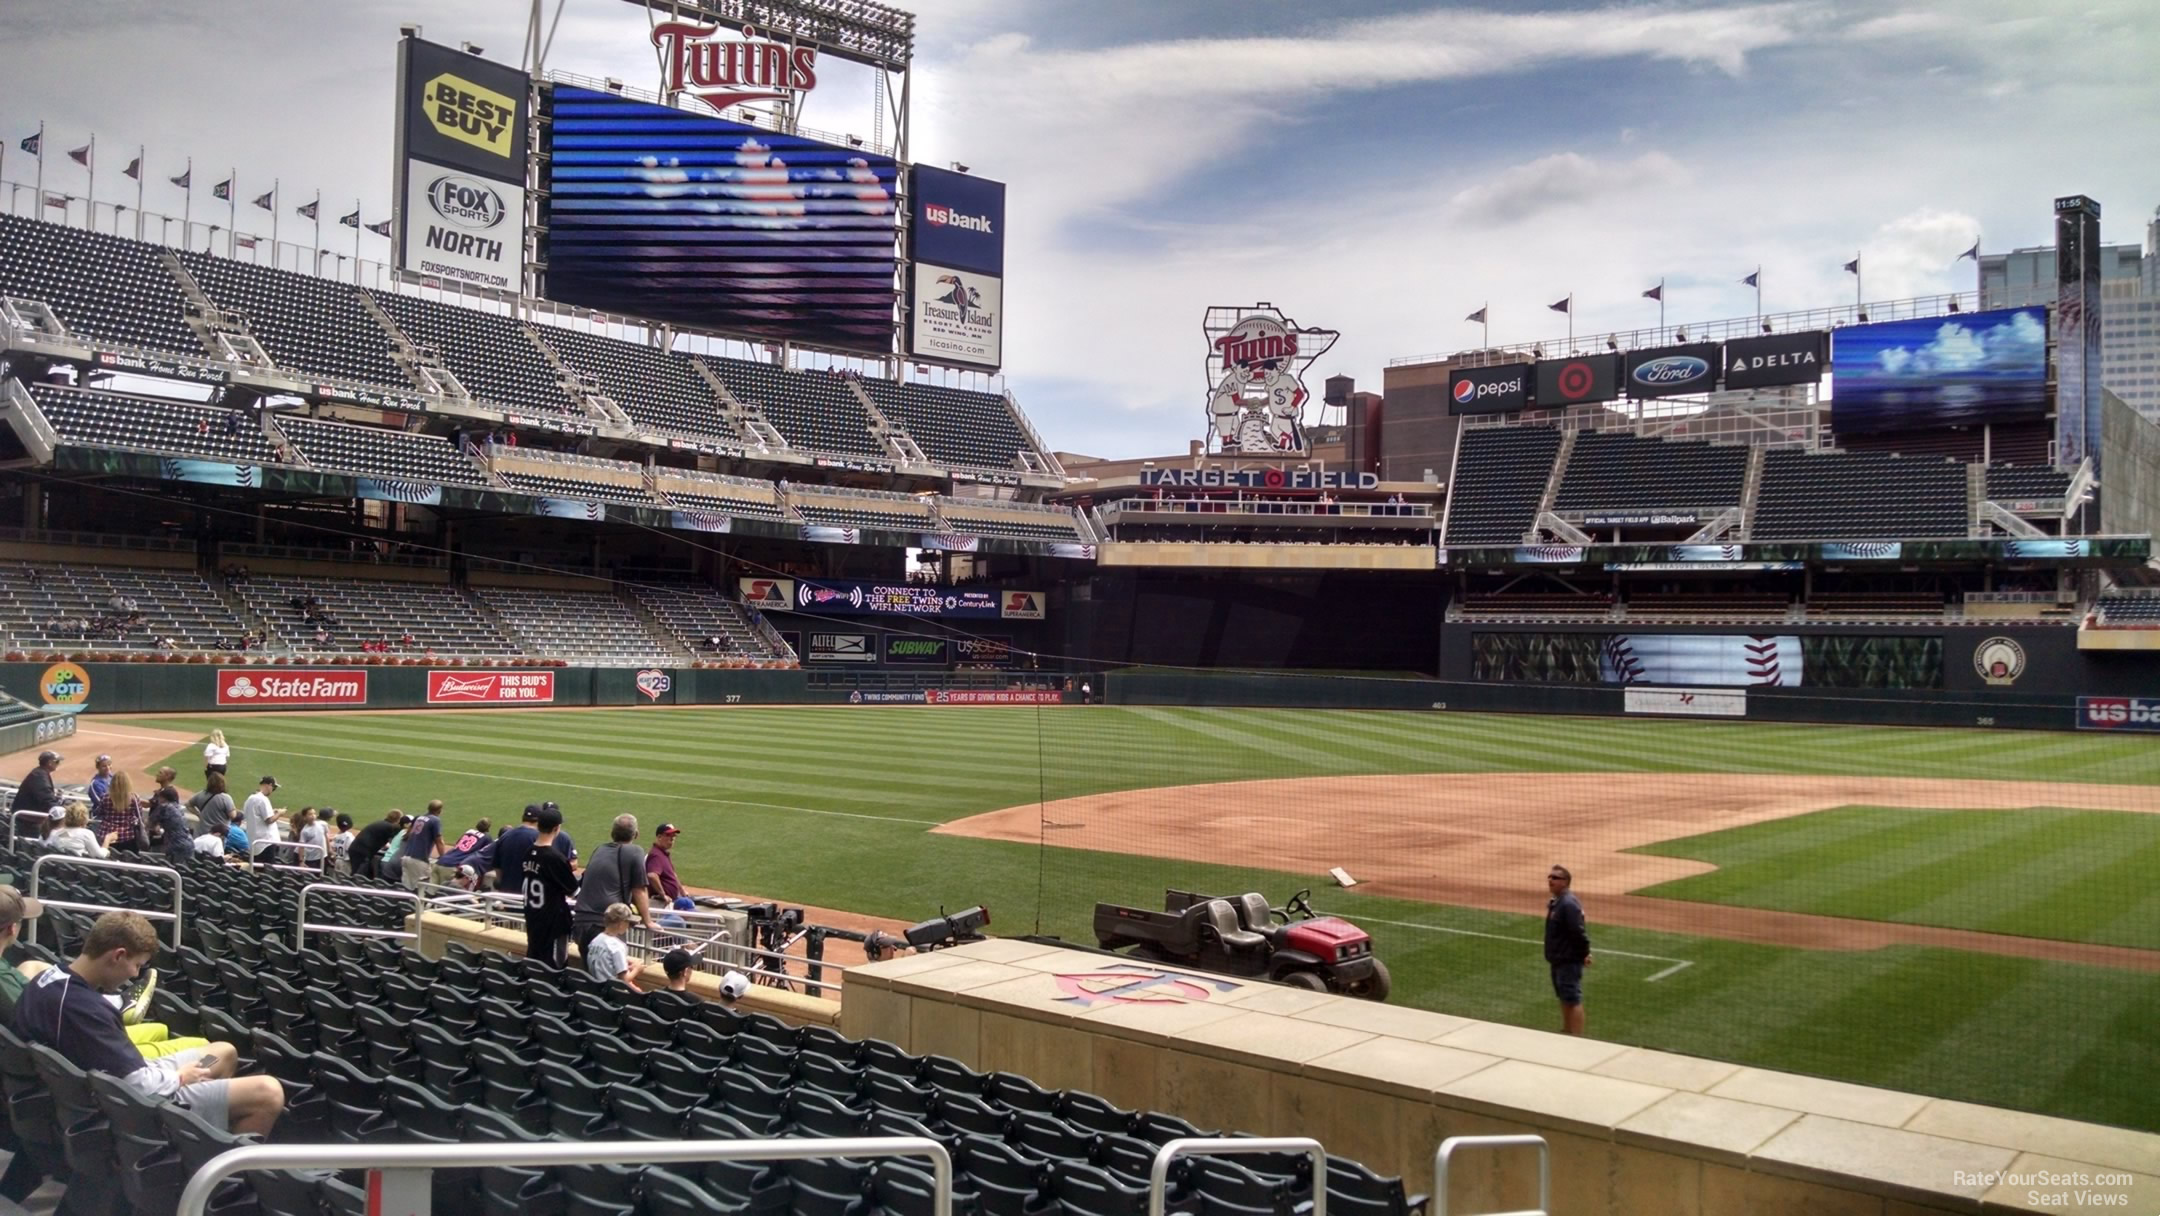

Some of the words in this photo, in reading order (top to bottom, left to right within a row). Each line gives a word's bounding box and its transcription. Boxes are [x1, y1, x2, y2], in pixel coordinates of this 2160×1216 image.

[651, 21, 817, 93] Twins
[435, 82, 513, 127] BEST
[436, 104, 505, 144] BUY
[444, 182, 489, 214] FOX
[443, 204, 490, 223] SPORTS
[426, 225, 503, 262] NORTH
[420, 260, 508, 287] FOXSPORTSNORTH.COM
[923, 301, 959, 322] Treasure
[967, 309, 993, 328] Island
[923, 319, 954, 328] RESORT
[963, 326, 993, 335] CASINO
[929, 338, 985, 355] ticasino.com
[1215, 330, 1298, 370] Twins
[1752, 352, 1816, 369] DELTA
[149, 361, 175, 375] Home
[177, 365, 197, 378] Run
[199, 369, 224, 382] Porch
[1648, 361, 1693, 382] Ford
[1477, 378, 1522, 399] pepsi
[359, 392, 380, 404] Home
[382, 396, 398, 408] Run
[1140, 468, 1260, 486] TARGET
[1292, 471, 1379, 489] FIELD
[1660, 514, 1696, 525] Ballpark
[865, 594, 885, 604] THE
[887, 595, 911, 605] FREE
[912, 596, 944, 606] TWINS
[873, 586, 921, 598] CONNECT
[922, 588, 936, 598] TO
[743, 599, 788, 608] ERAMERICA
[869, 602, 892, 612] WIFI
[893, 602, 942, 614] NETWORK
[958, 600, 996, 609] CenturyLink
[888, 640, 945, 656] SUBWAY
[55, 668, 74, 681] go
[500, 675, 520, 686] THIS
[521, 675, 547, 687] BUD'S
[46, 682, 85, 696] VOTE
[443, 681, 489, 692] Budweiser
[652, 676, 669, 690] 29
[499, 687, 517, 698] FOR
[518, 687, 538, 698] YOU.
[726, 695, 741, 703] 377
[864, 693, 880, 701] TWINS
[881, 693, 911, 701] COMMUNITY
[911, 693, 925, 701] FUND
[936, 691, 949, 702] 25
[949, 693, 968, 702] YEARS
[969, 693, 976, 702] OF
[977, 693, 996, 702] GIVING
[996, 693, 1009, 702] KIDS
[1009, 693, 1014, 702] A
[1015, 693, 1036, 702] CHANCE
[1037, 693, 1044, 702] TO
[1044, 693, 1060, 702] PLAY.
[522, 860, 541, 874] SALE
[522, 877, 545, 909] 49
